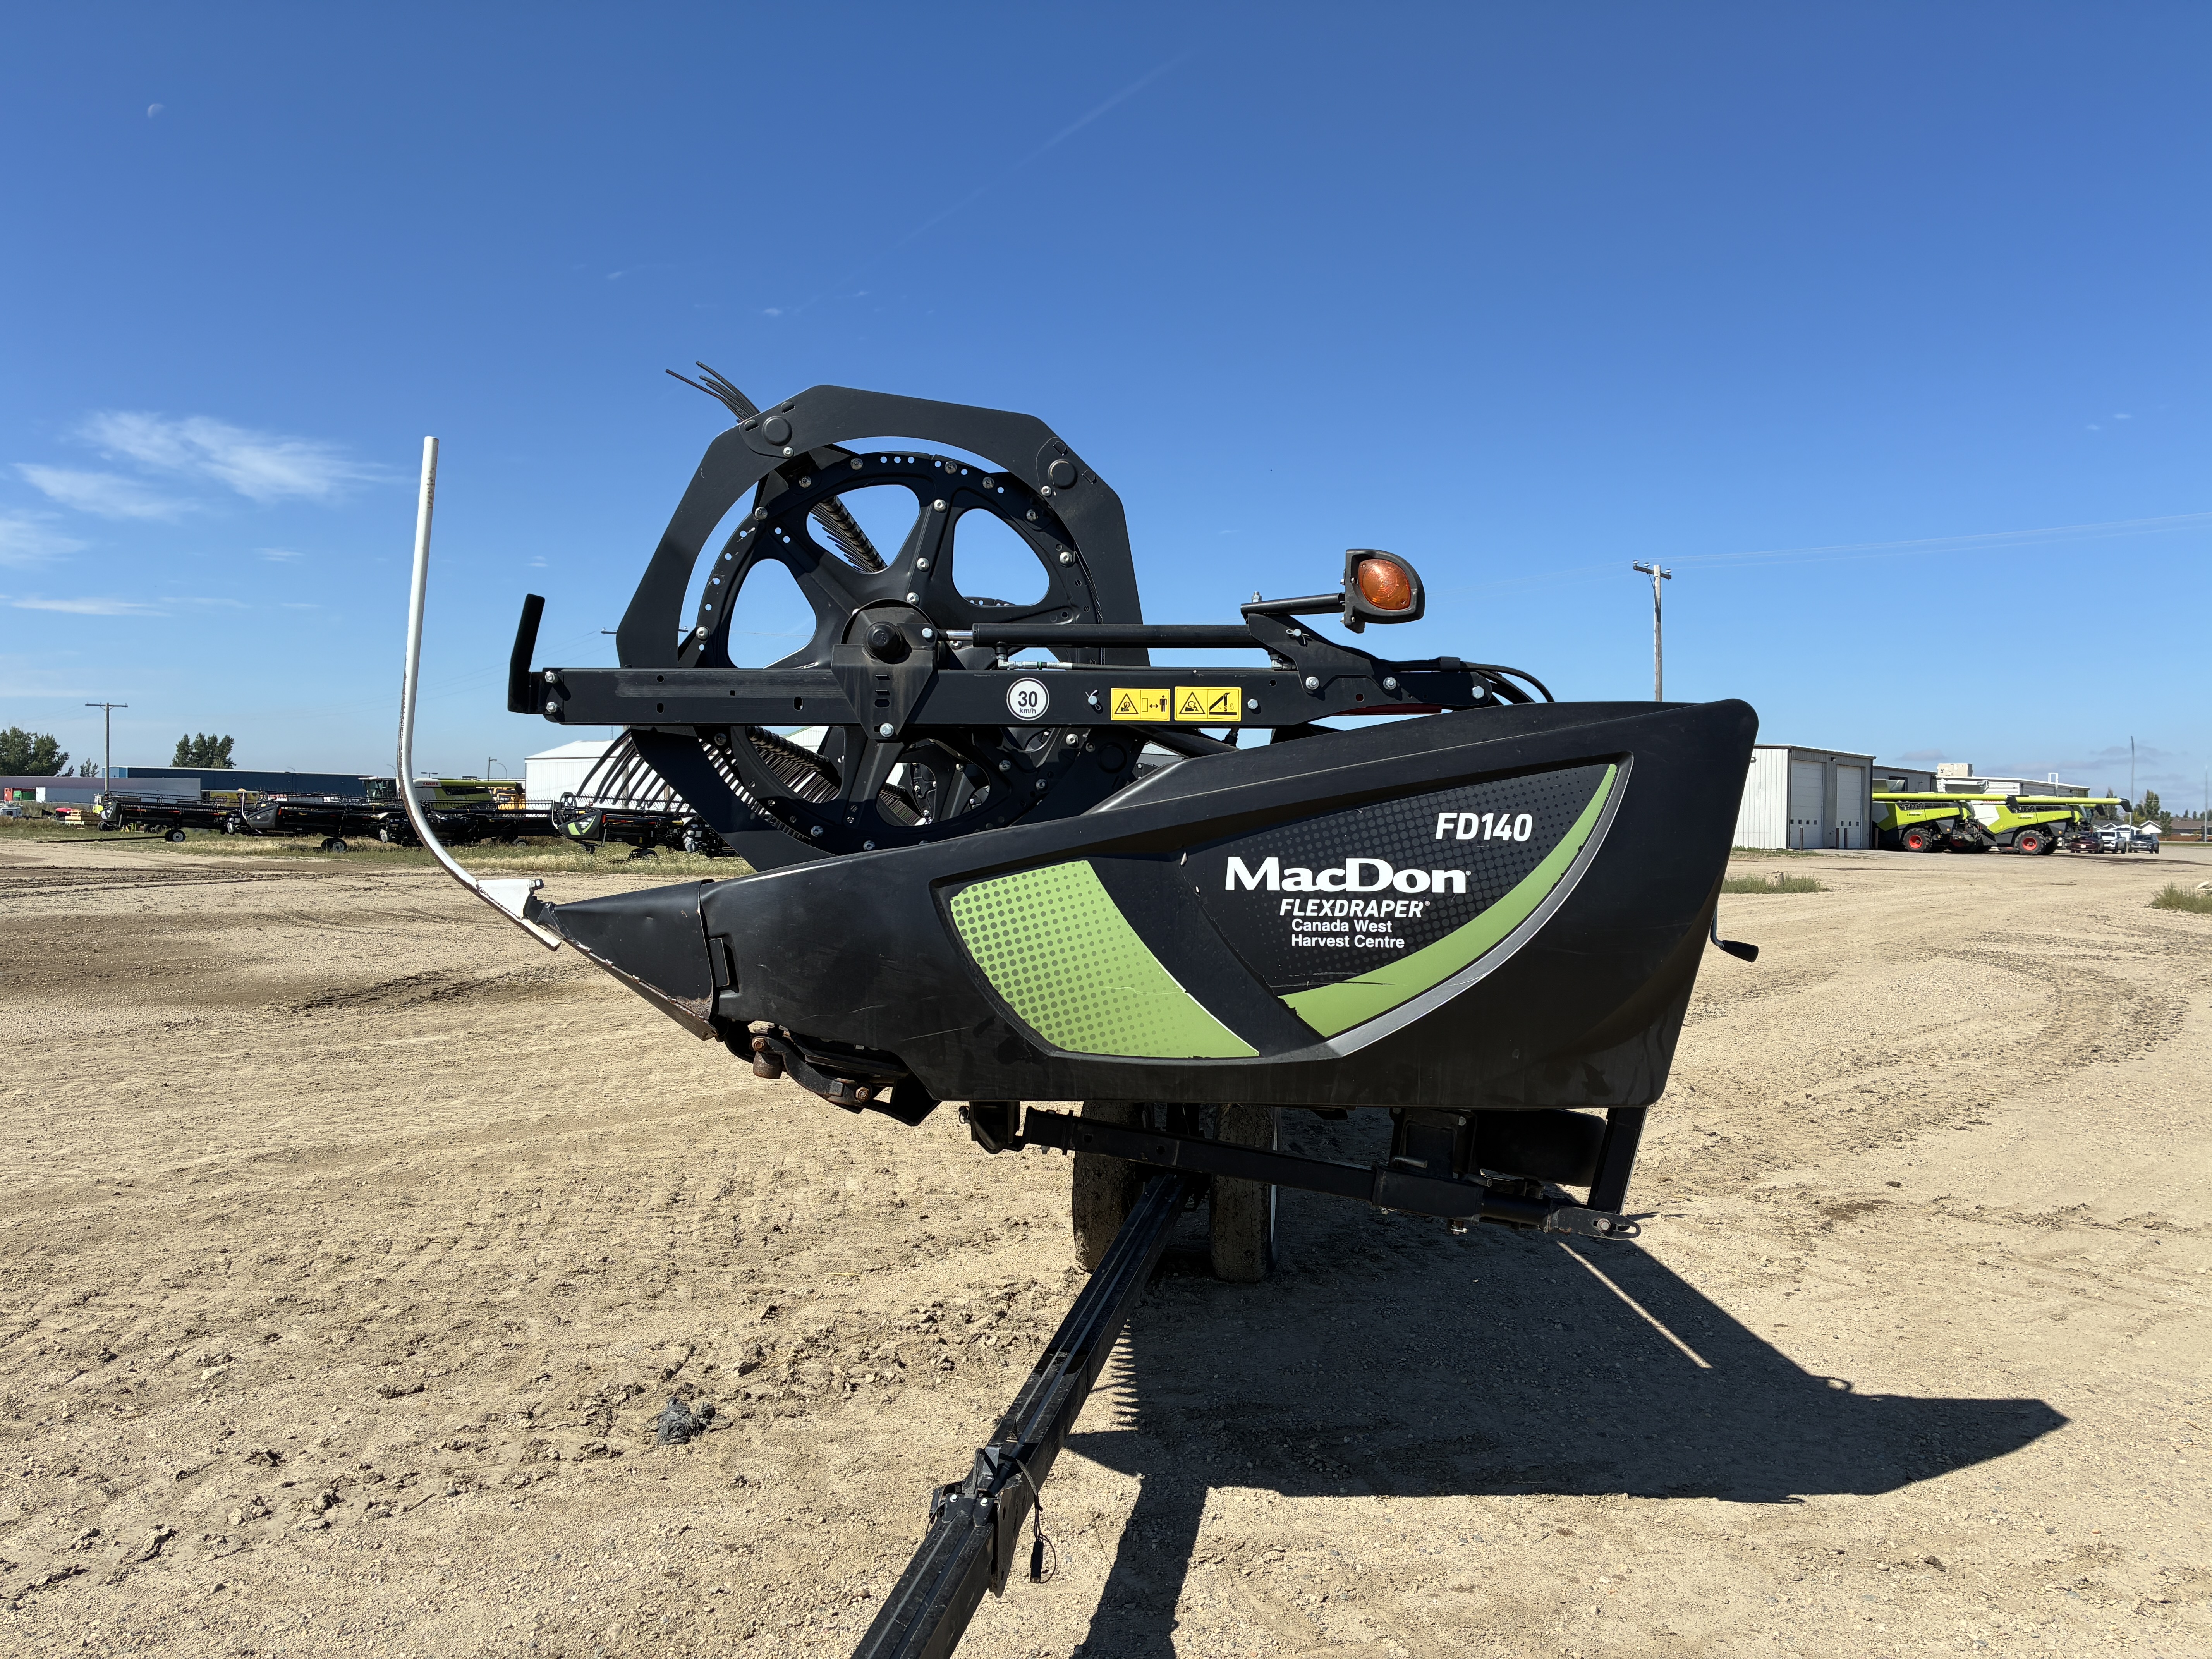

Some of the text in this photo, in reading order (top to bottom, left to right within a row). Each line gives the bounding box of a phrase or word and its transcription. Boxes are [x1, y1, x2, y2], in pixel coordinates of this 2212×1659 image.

[1018, 690, 1038, 708] 30
[1435, 812, 1532, 842] FD140
[1225, 856, 1466, 893] MacDon
[1279, 898, 1424, 918] FLEXDRAPER
[1292, 918, 1392, 933] Canada West
[1291, 934, 1405, 948] Harvest Centre
